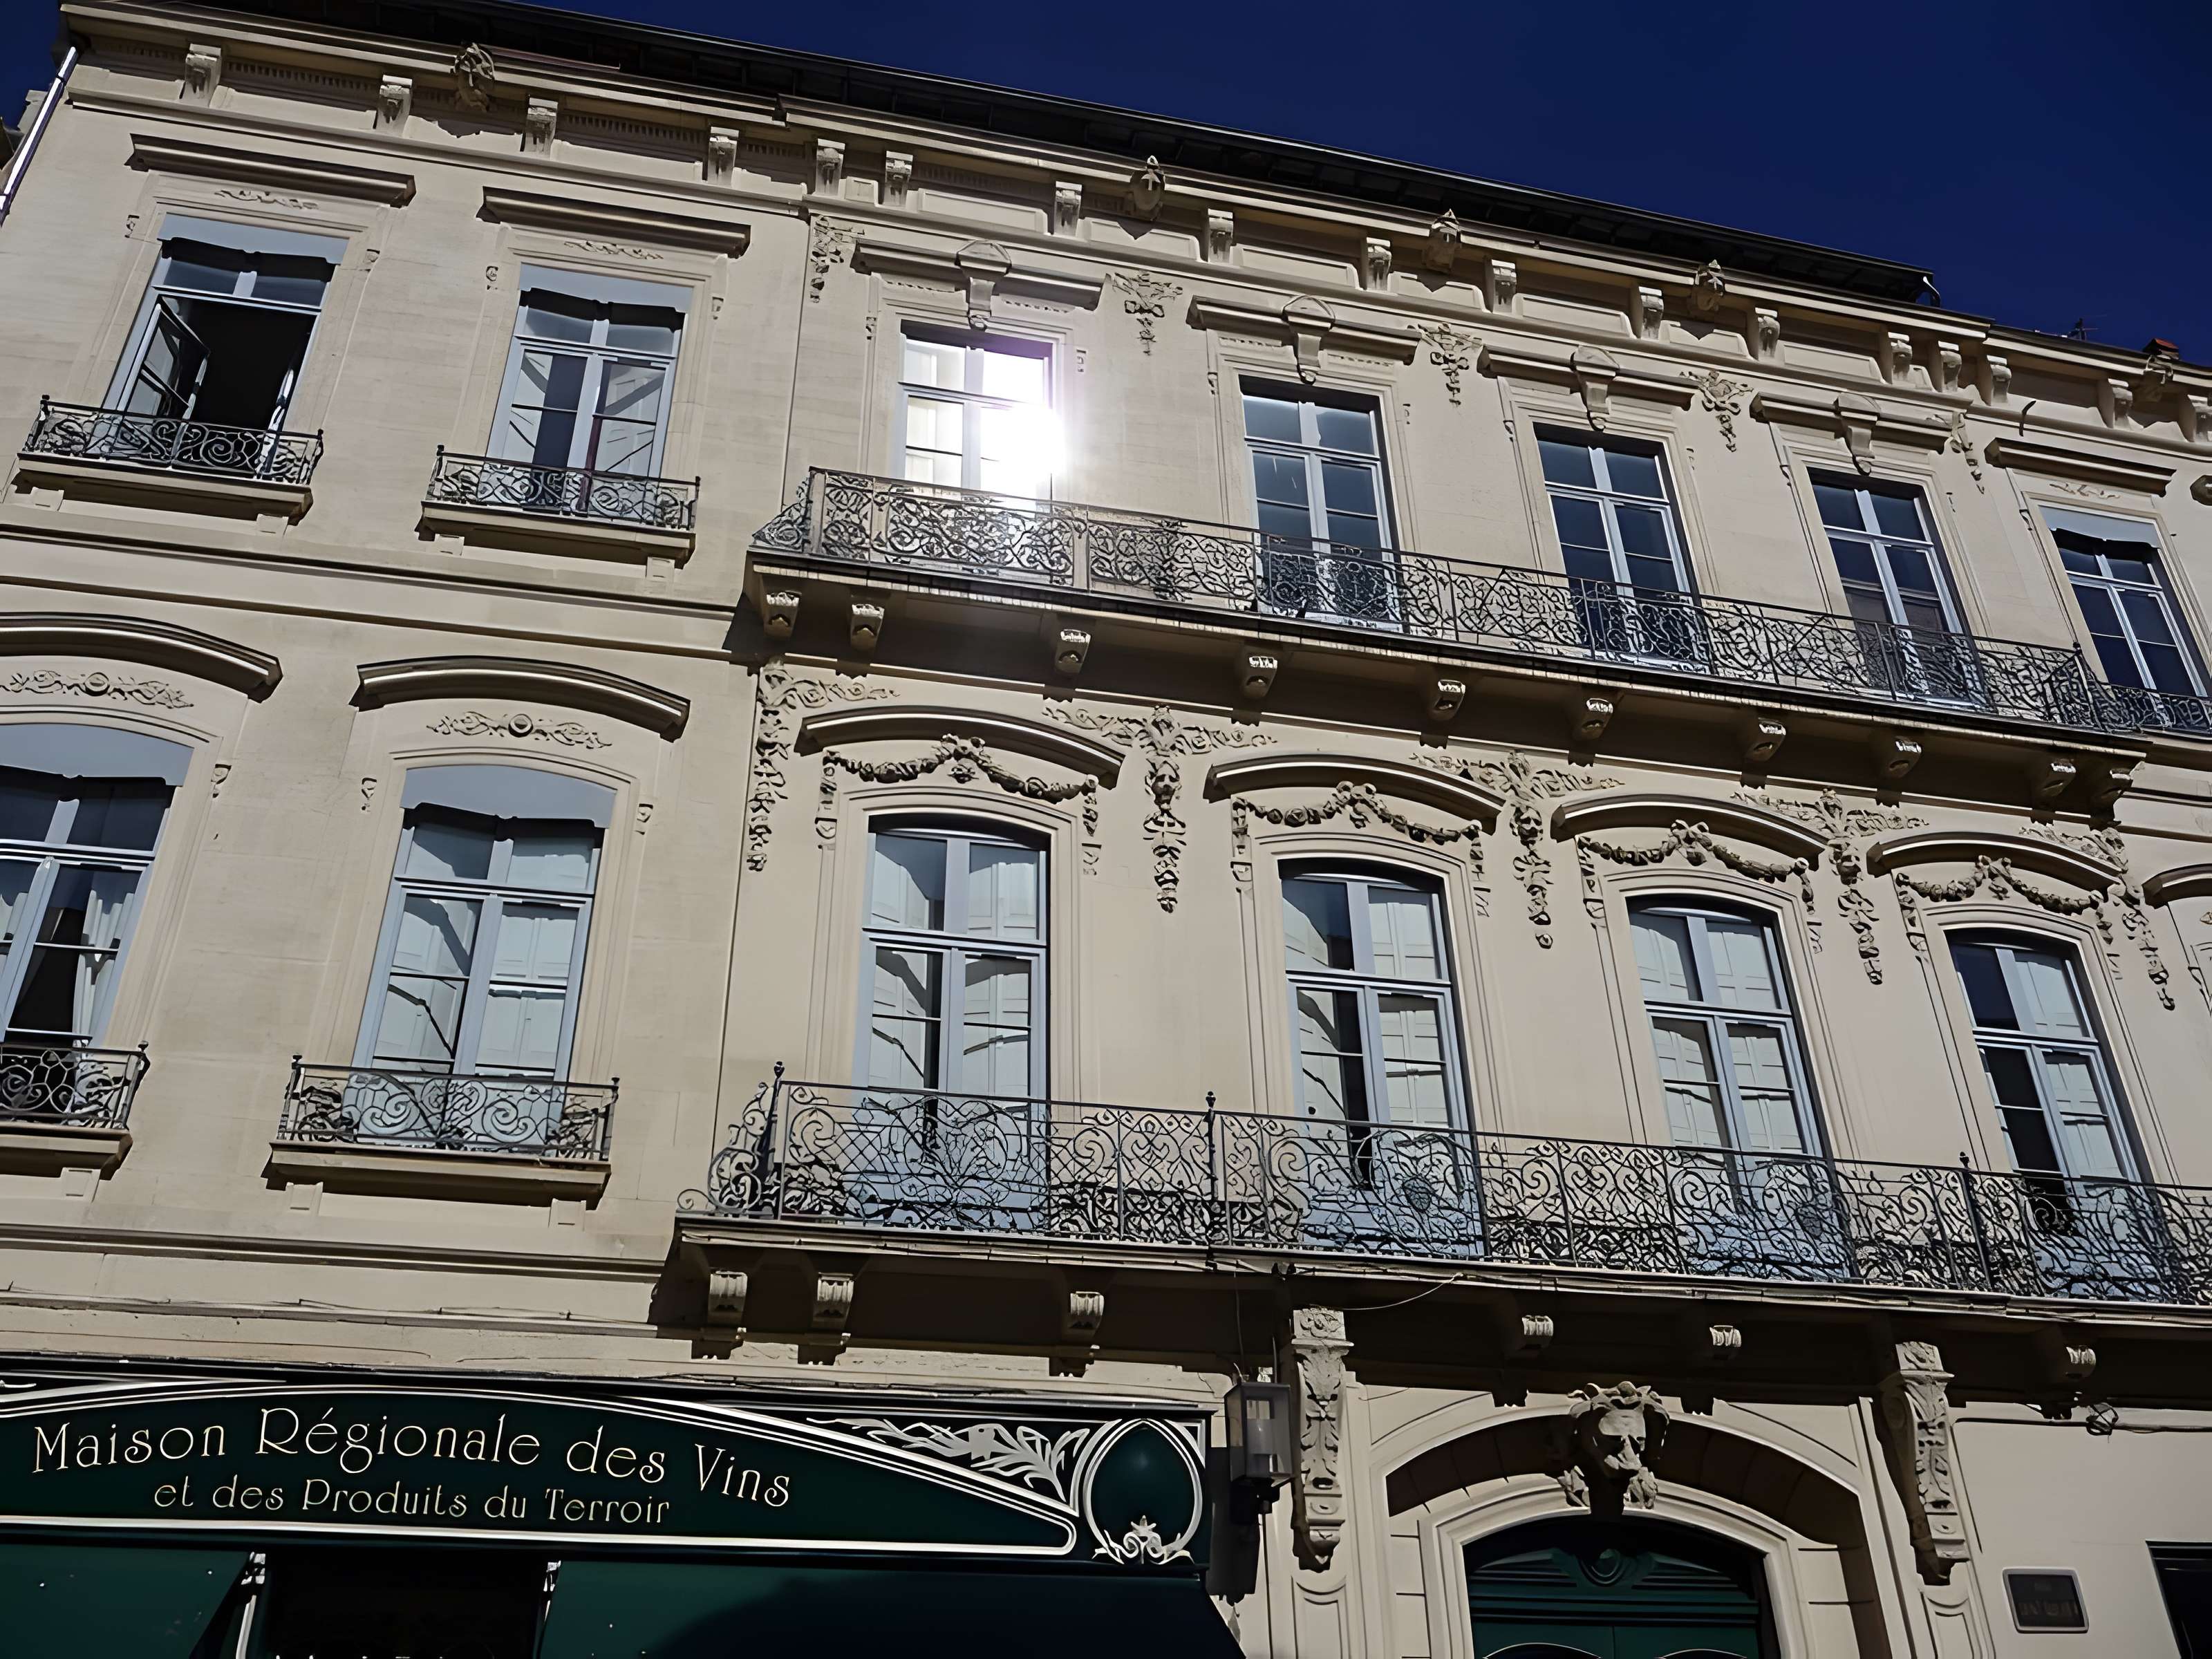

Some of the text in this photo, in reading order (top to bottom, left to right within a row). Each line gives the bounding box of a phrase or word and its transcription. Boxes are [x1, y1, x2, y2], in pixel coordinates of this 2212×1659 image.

[32, 1407, 790, 1508] Maison Régionale des Vins
[154, 1474, 670, 1524] et des Produits du Terroir
